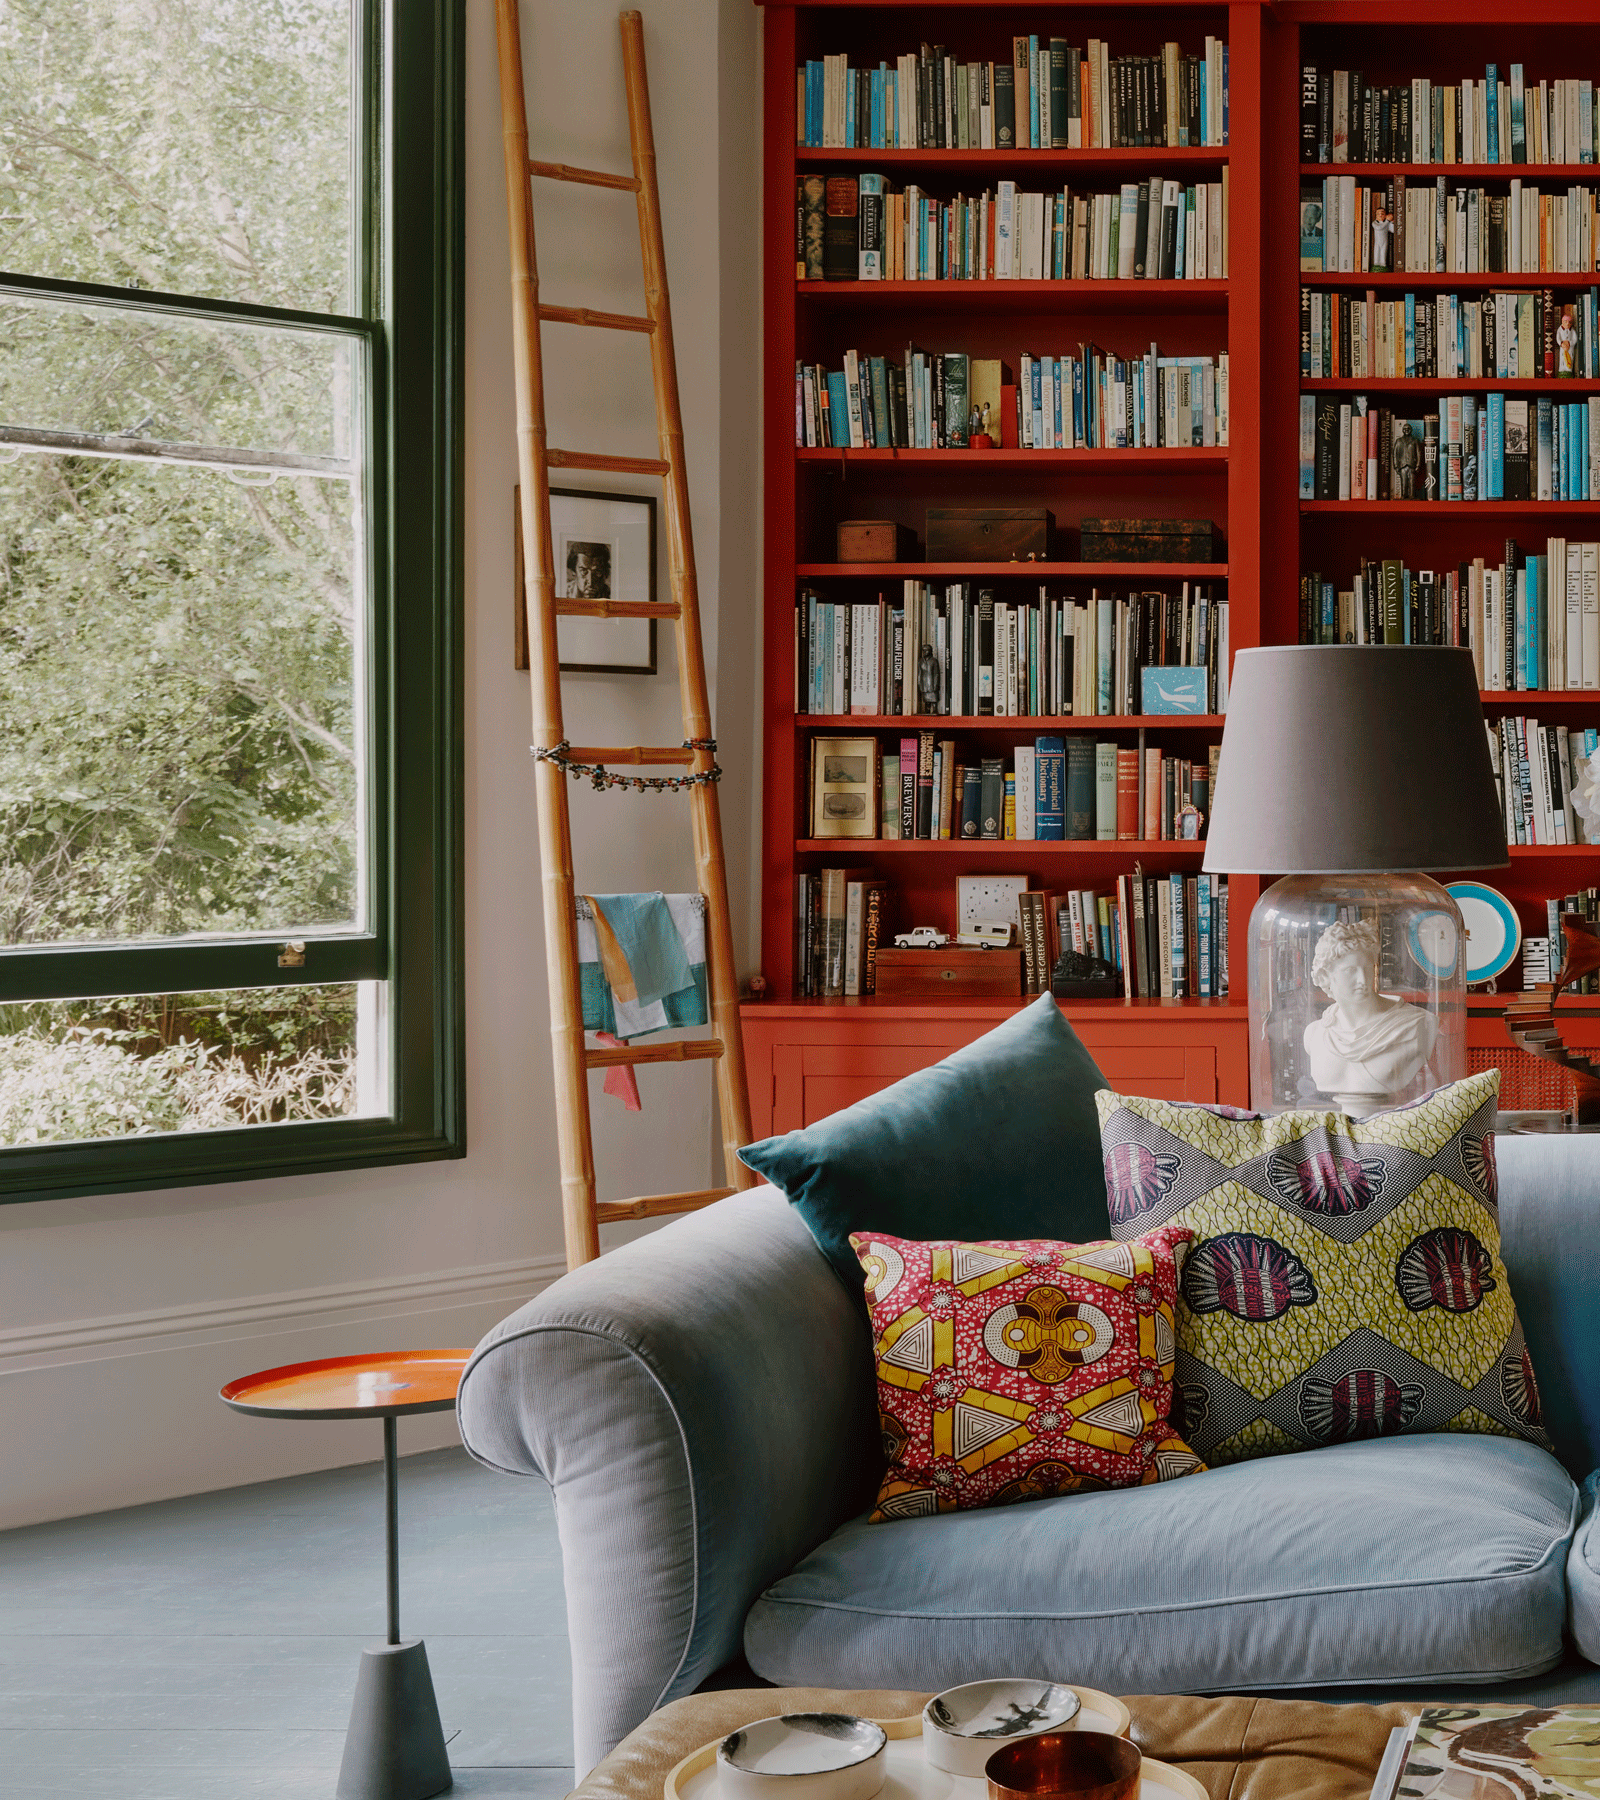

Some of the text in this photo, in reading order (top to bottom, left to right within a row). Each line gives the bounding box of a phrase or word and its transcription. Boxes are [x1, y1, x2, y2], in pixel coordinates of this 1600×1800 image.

[1303, 74, 1316, 107] PEEL
[1387, 566, 1397, 630] CONSTABLE
[894, 628, 903, 680] DUNCAN FLETCHER
[996, 651, 1004, 676] Identify
[904, 776, 912, 826] BREWER'S
[1038, 759, 1048, 802] Dictionary
[1050, 759, 1060, 810] Biographical
[1517, 737, 1533, 826] TOM PHILLIPS
[1133, 883, 1143, 919] HENRY MOORE
[1162, 931, 1168, 939] TO
[1382, 927, 1393, 965] DALI
